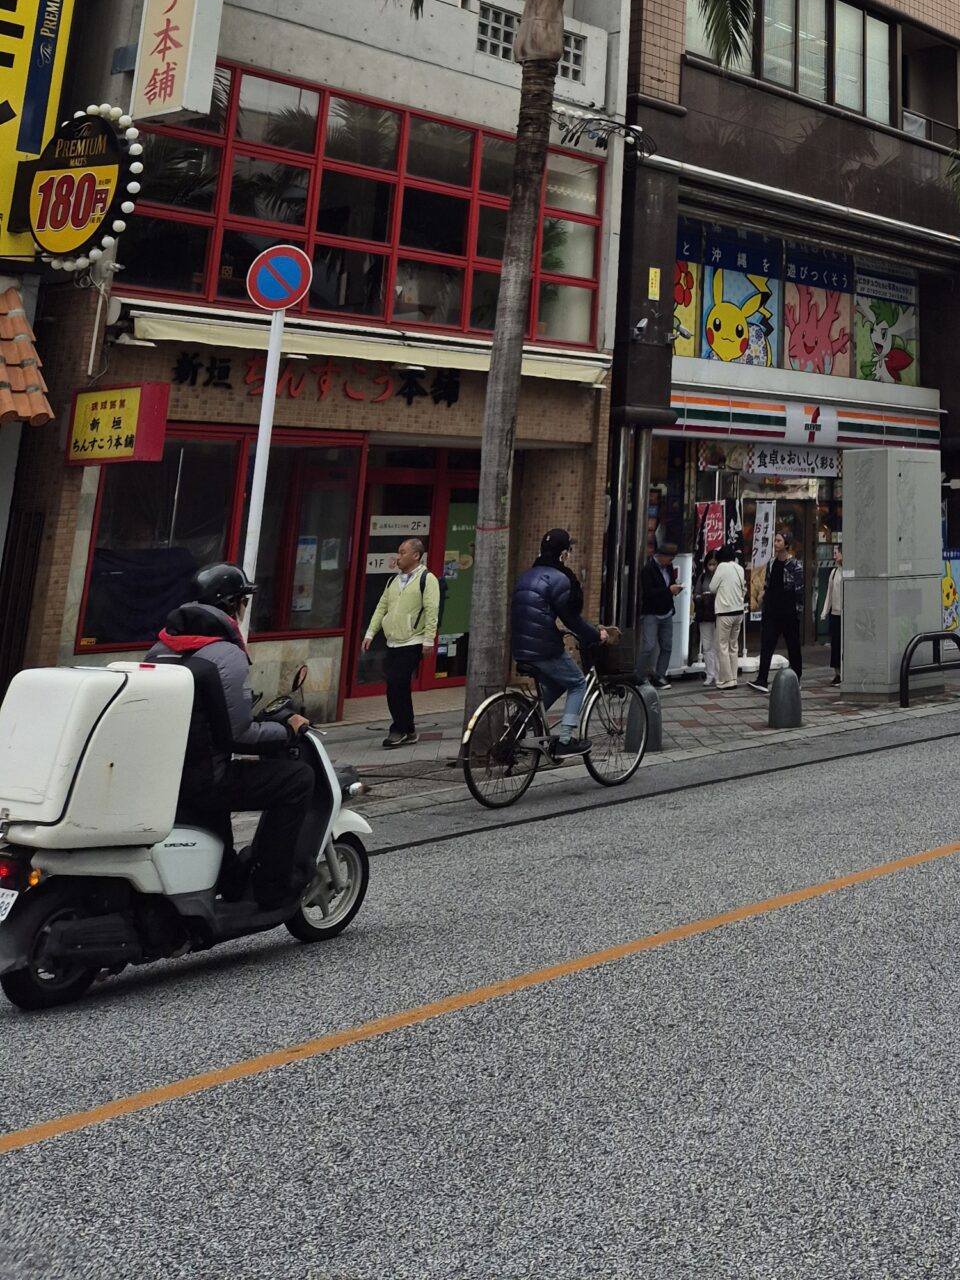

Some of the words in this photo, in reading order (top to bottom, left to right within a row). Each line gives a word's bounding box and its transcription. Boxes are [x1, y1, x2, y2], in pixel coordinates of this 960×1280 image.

[55, 134, 108, 159] PREMIUM
[72, 433, 135, 453] ちんすこう本舗
[757, 450, 835, 470] 食卓をおいしく彩る
[411, 521, 422, 531] 2F
[374, 559, 384, 568] 1F
